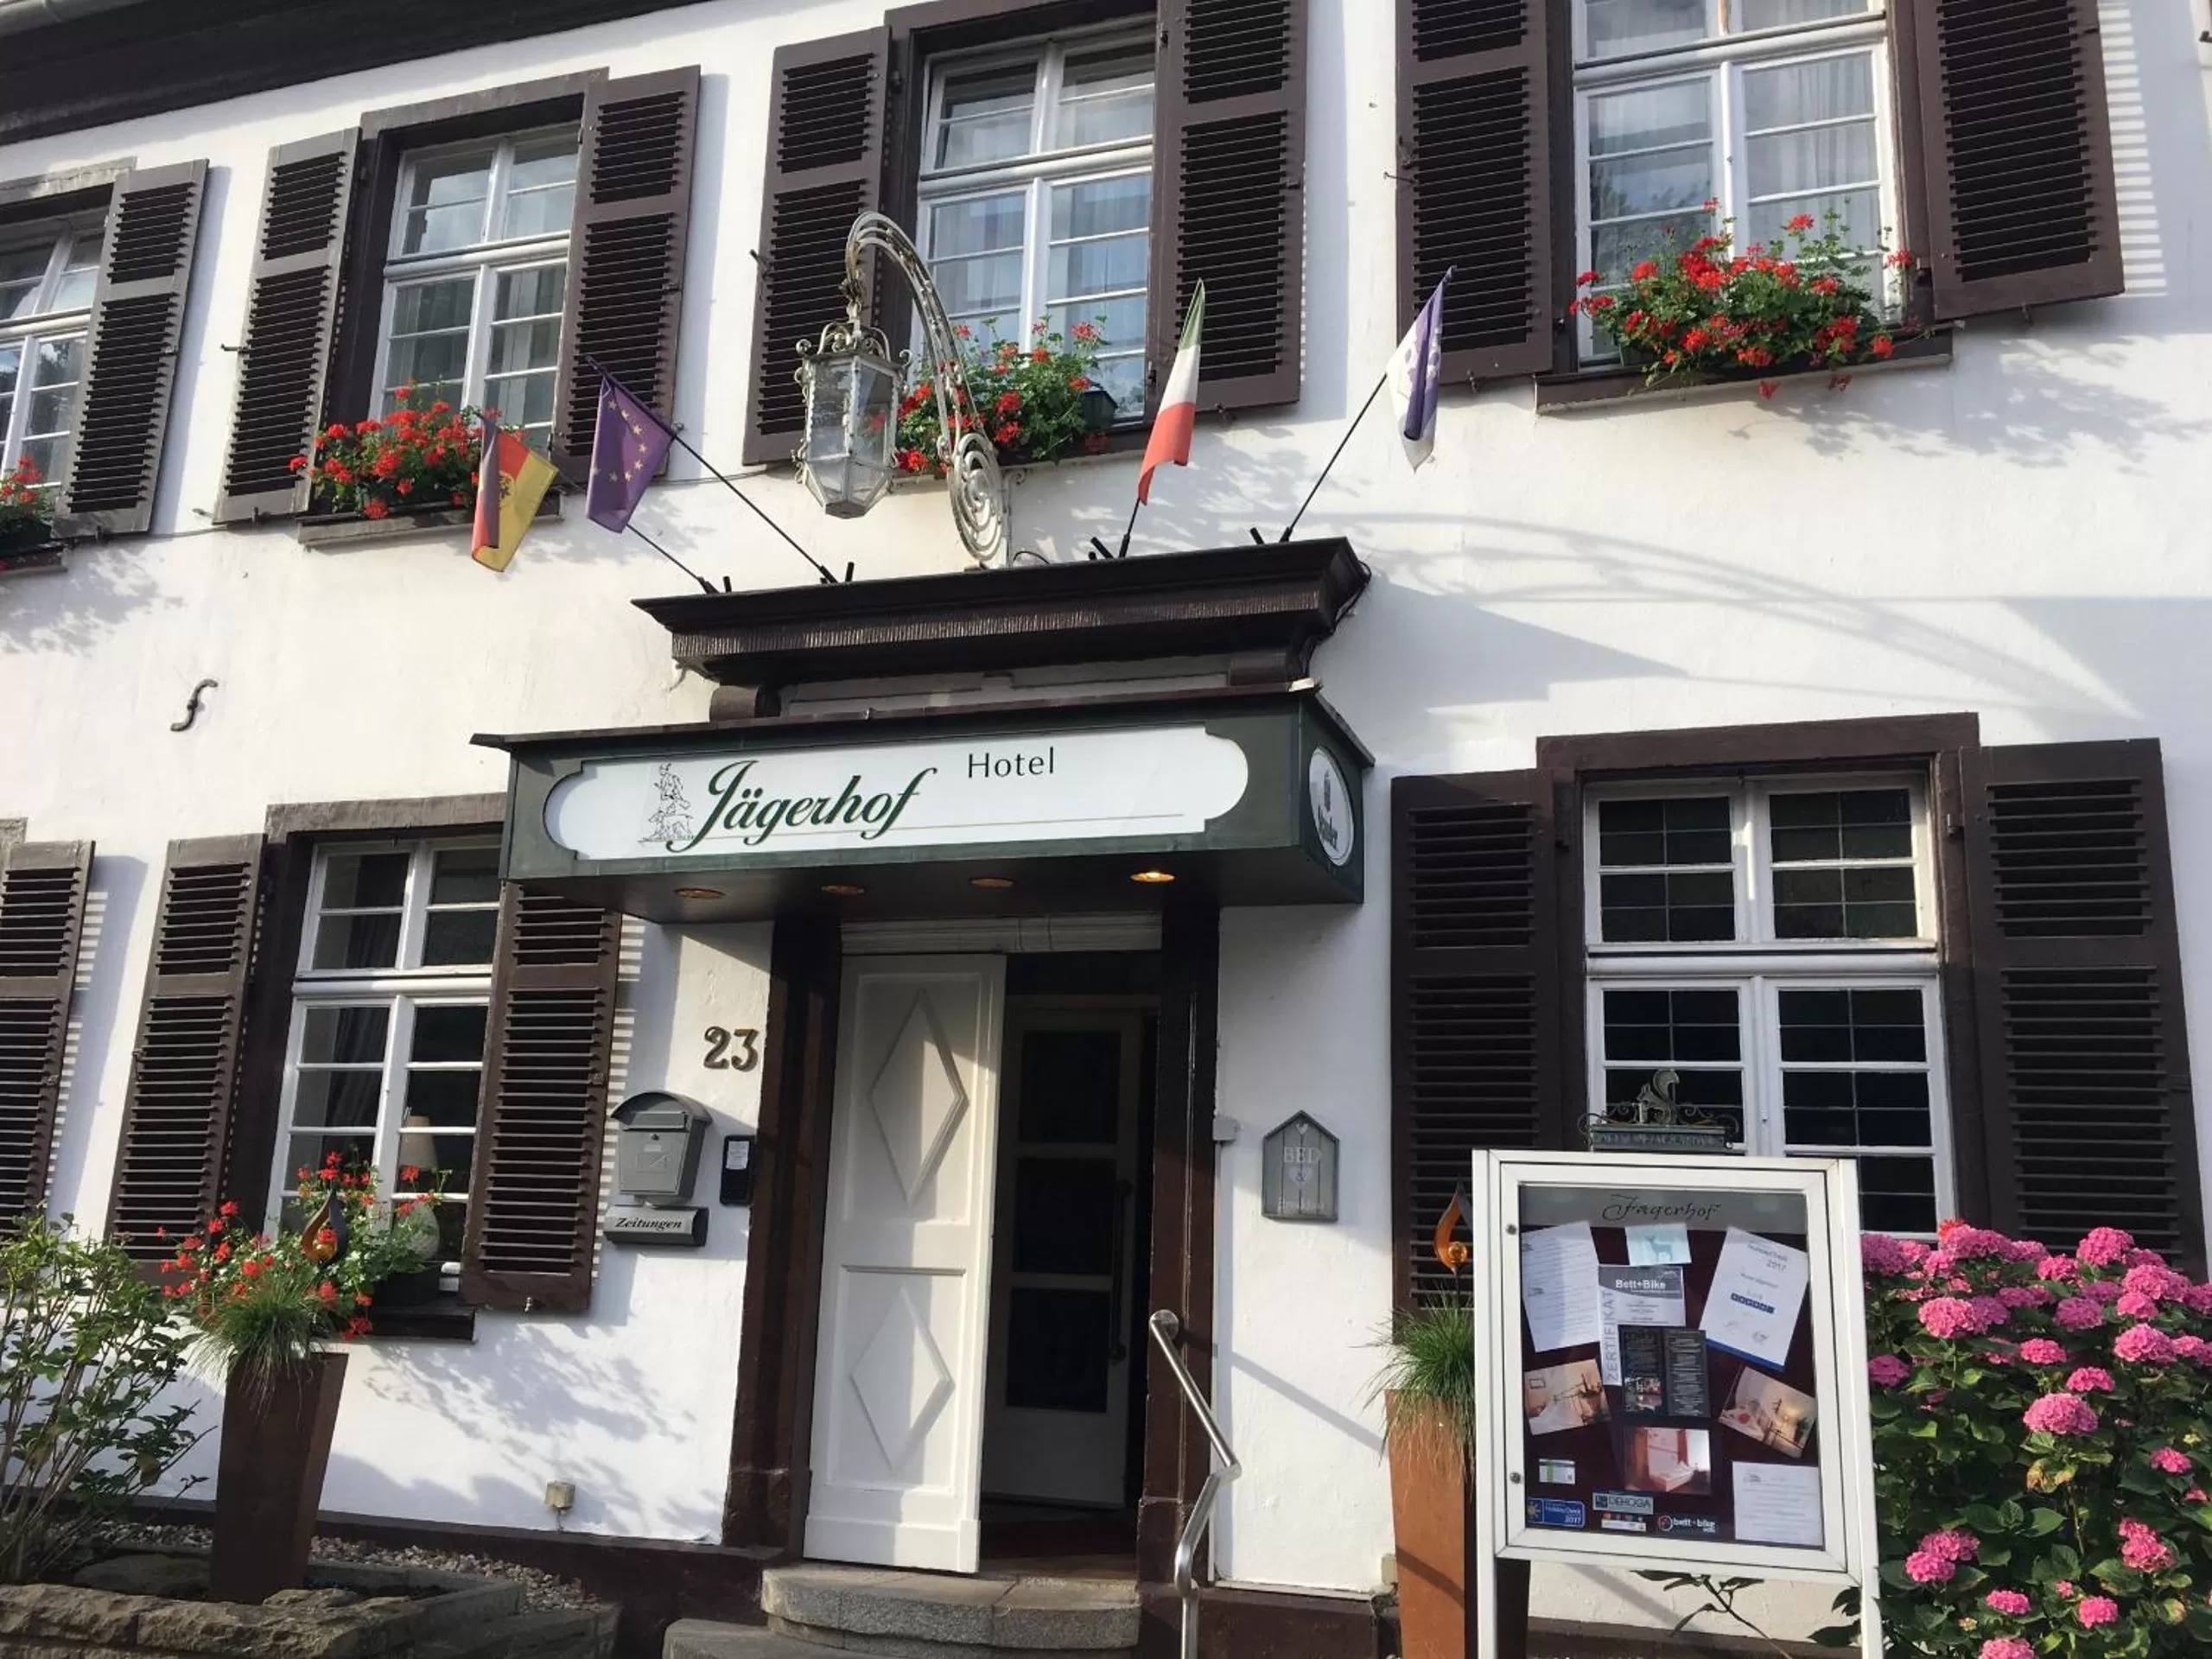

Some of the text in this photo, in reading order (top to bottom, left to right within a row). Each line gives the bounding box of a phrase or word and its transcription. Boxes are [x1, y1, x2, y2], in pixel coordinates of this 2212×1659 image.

[967, 747, 1055, 779] Hotel
[666, 760, 938, 853] Jägerhof
[702, 1026, 760, 1072] 23
[615, 1217, 683, 1231] Zeitungen
[1601, 1290, 1619, 1382] ZERTIFIKAT
